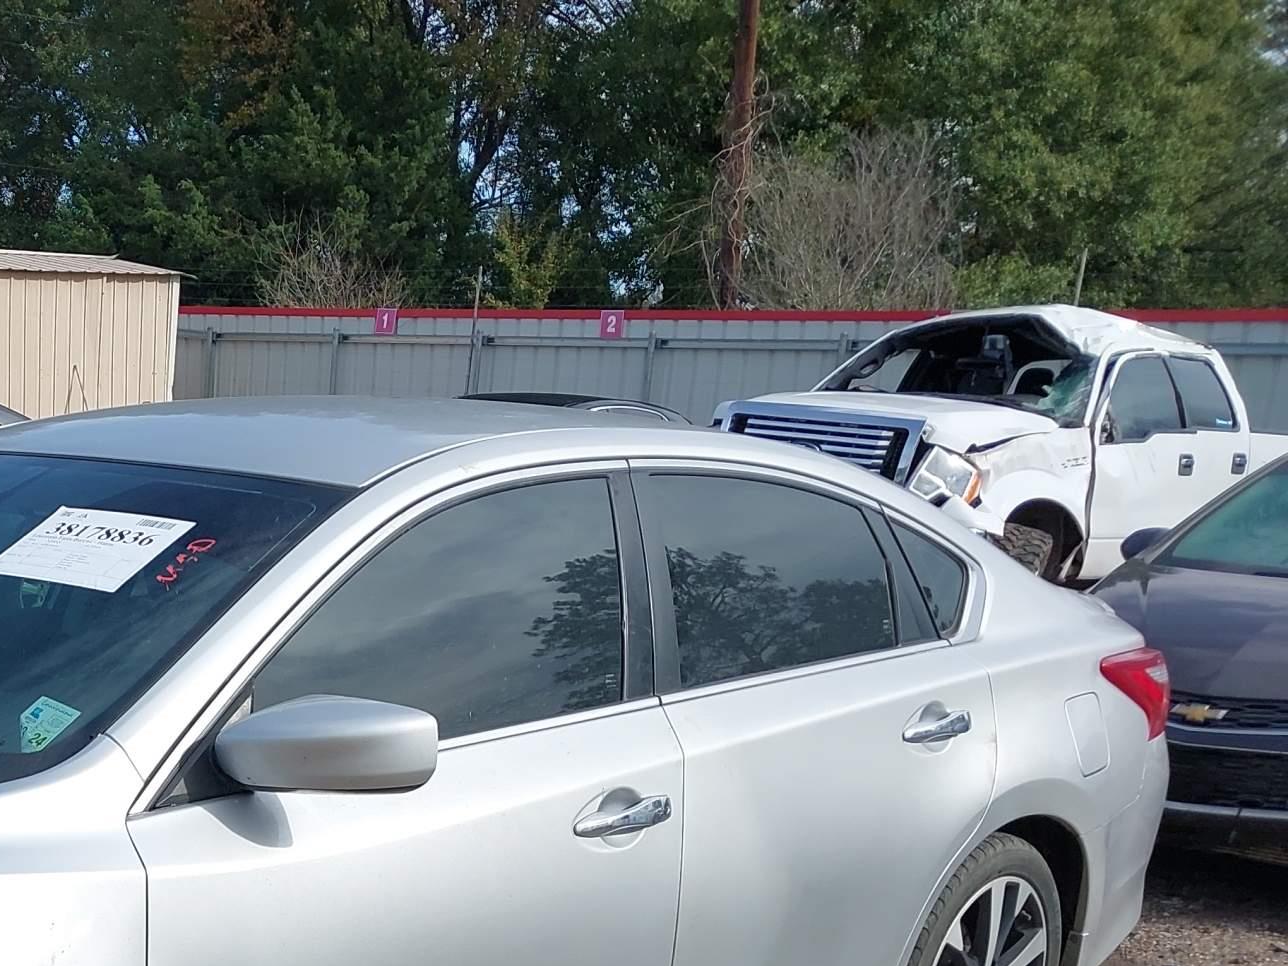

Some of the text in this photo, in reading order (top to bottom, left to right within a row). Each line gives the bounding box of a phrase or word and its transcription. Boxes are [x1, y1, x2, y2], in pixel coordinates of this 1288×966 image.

[382, 313, 388, 329] 1
[606, 315, 617, 333] 2
[46, 522, 161, 547] 38178836
[28, 732, 48, 747] 24
